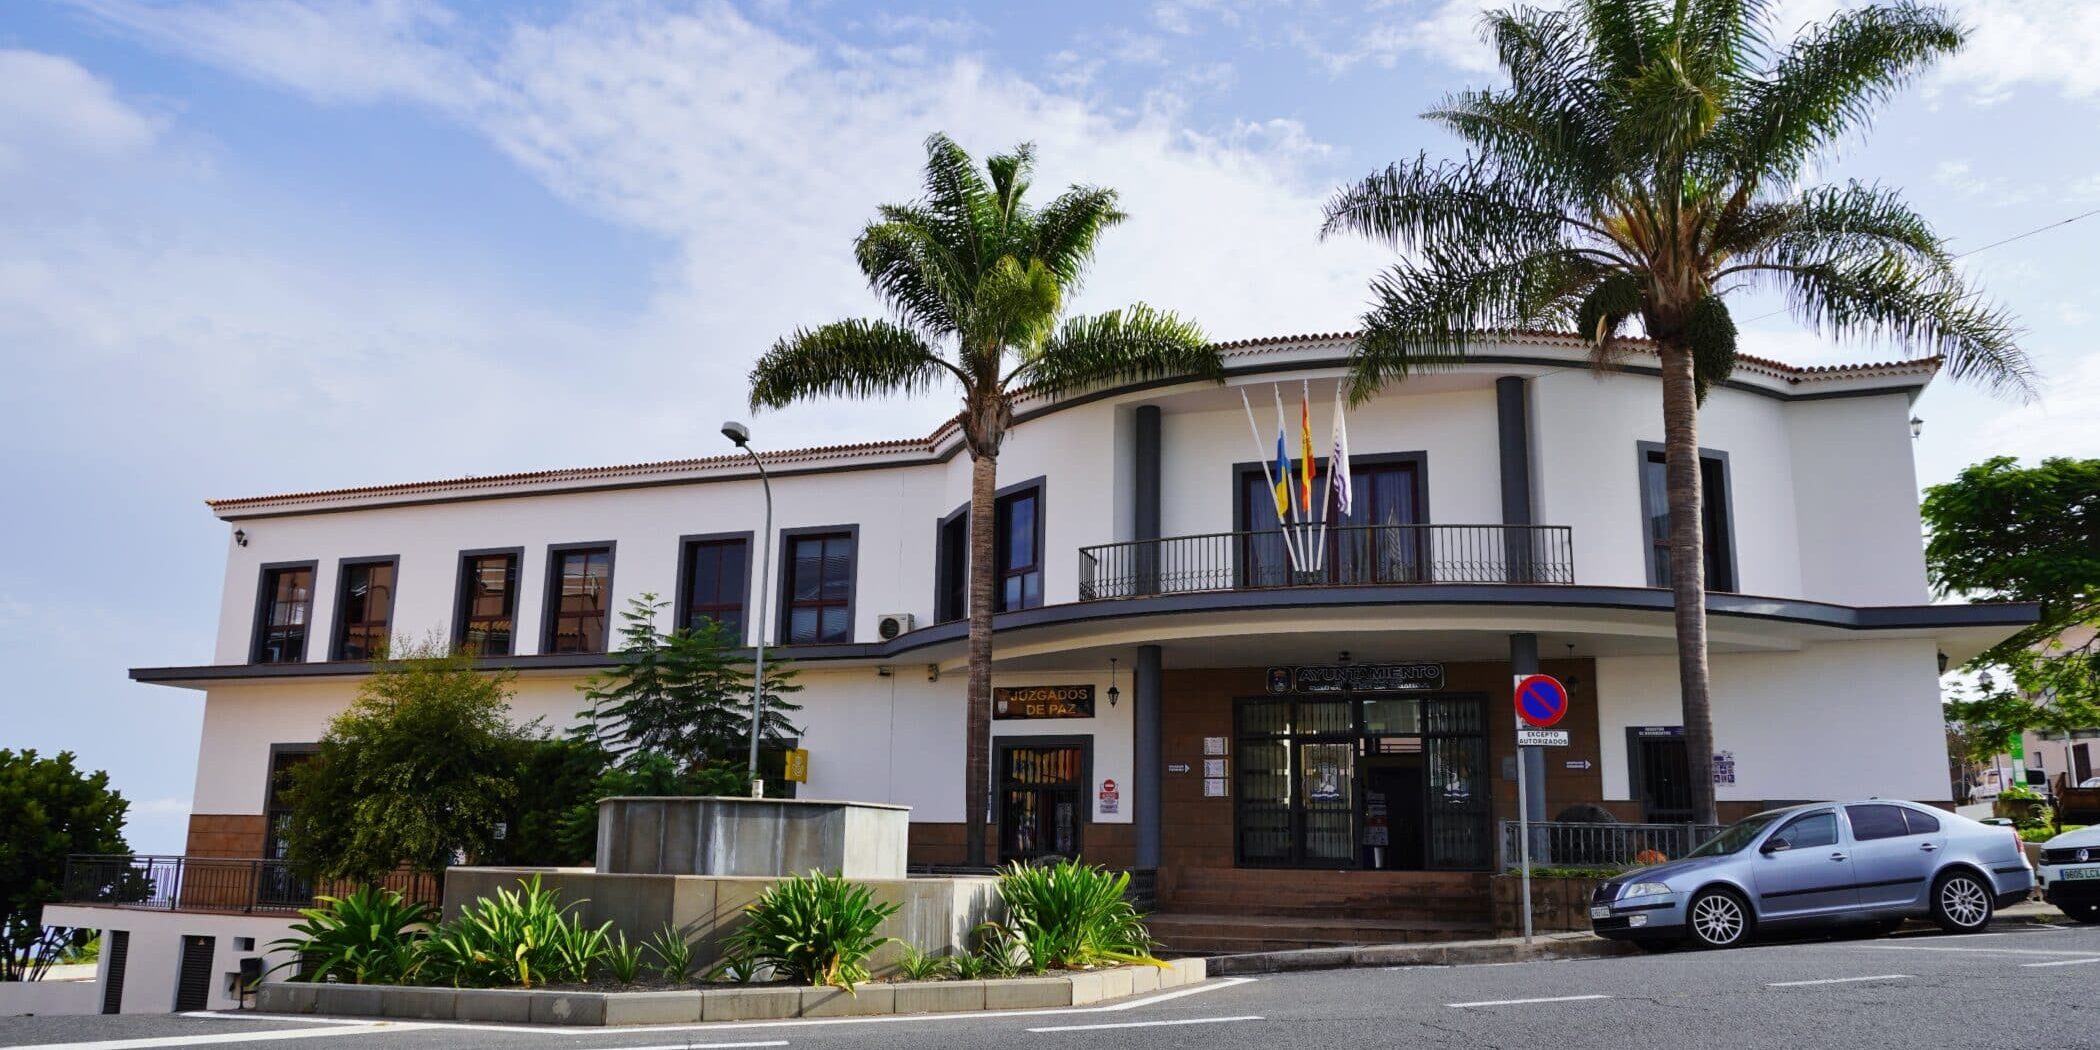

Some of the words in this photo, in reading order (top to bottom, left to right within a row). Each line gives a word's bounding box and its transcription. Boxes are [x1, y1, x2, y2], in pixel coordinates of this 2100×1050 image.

[1300, 665, 1440, 682] AYUNTAMIENTO
[1010, 689, 1088, 701] JUZGADOS
[1026, 704, 1045, 715] DE
[1049, 703, 1076, 714] PAZ
